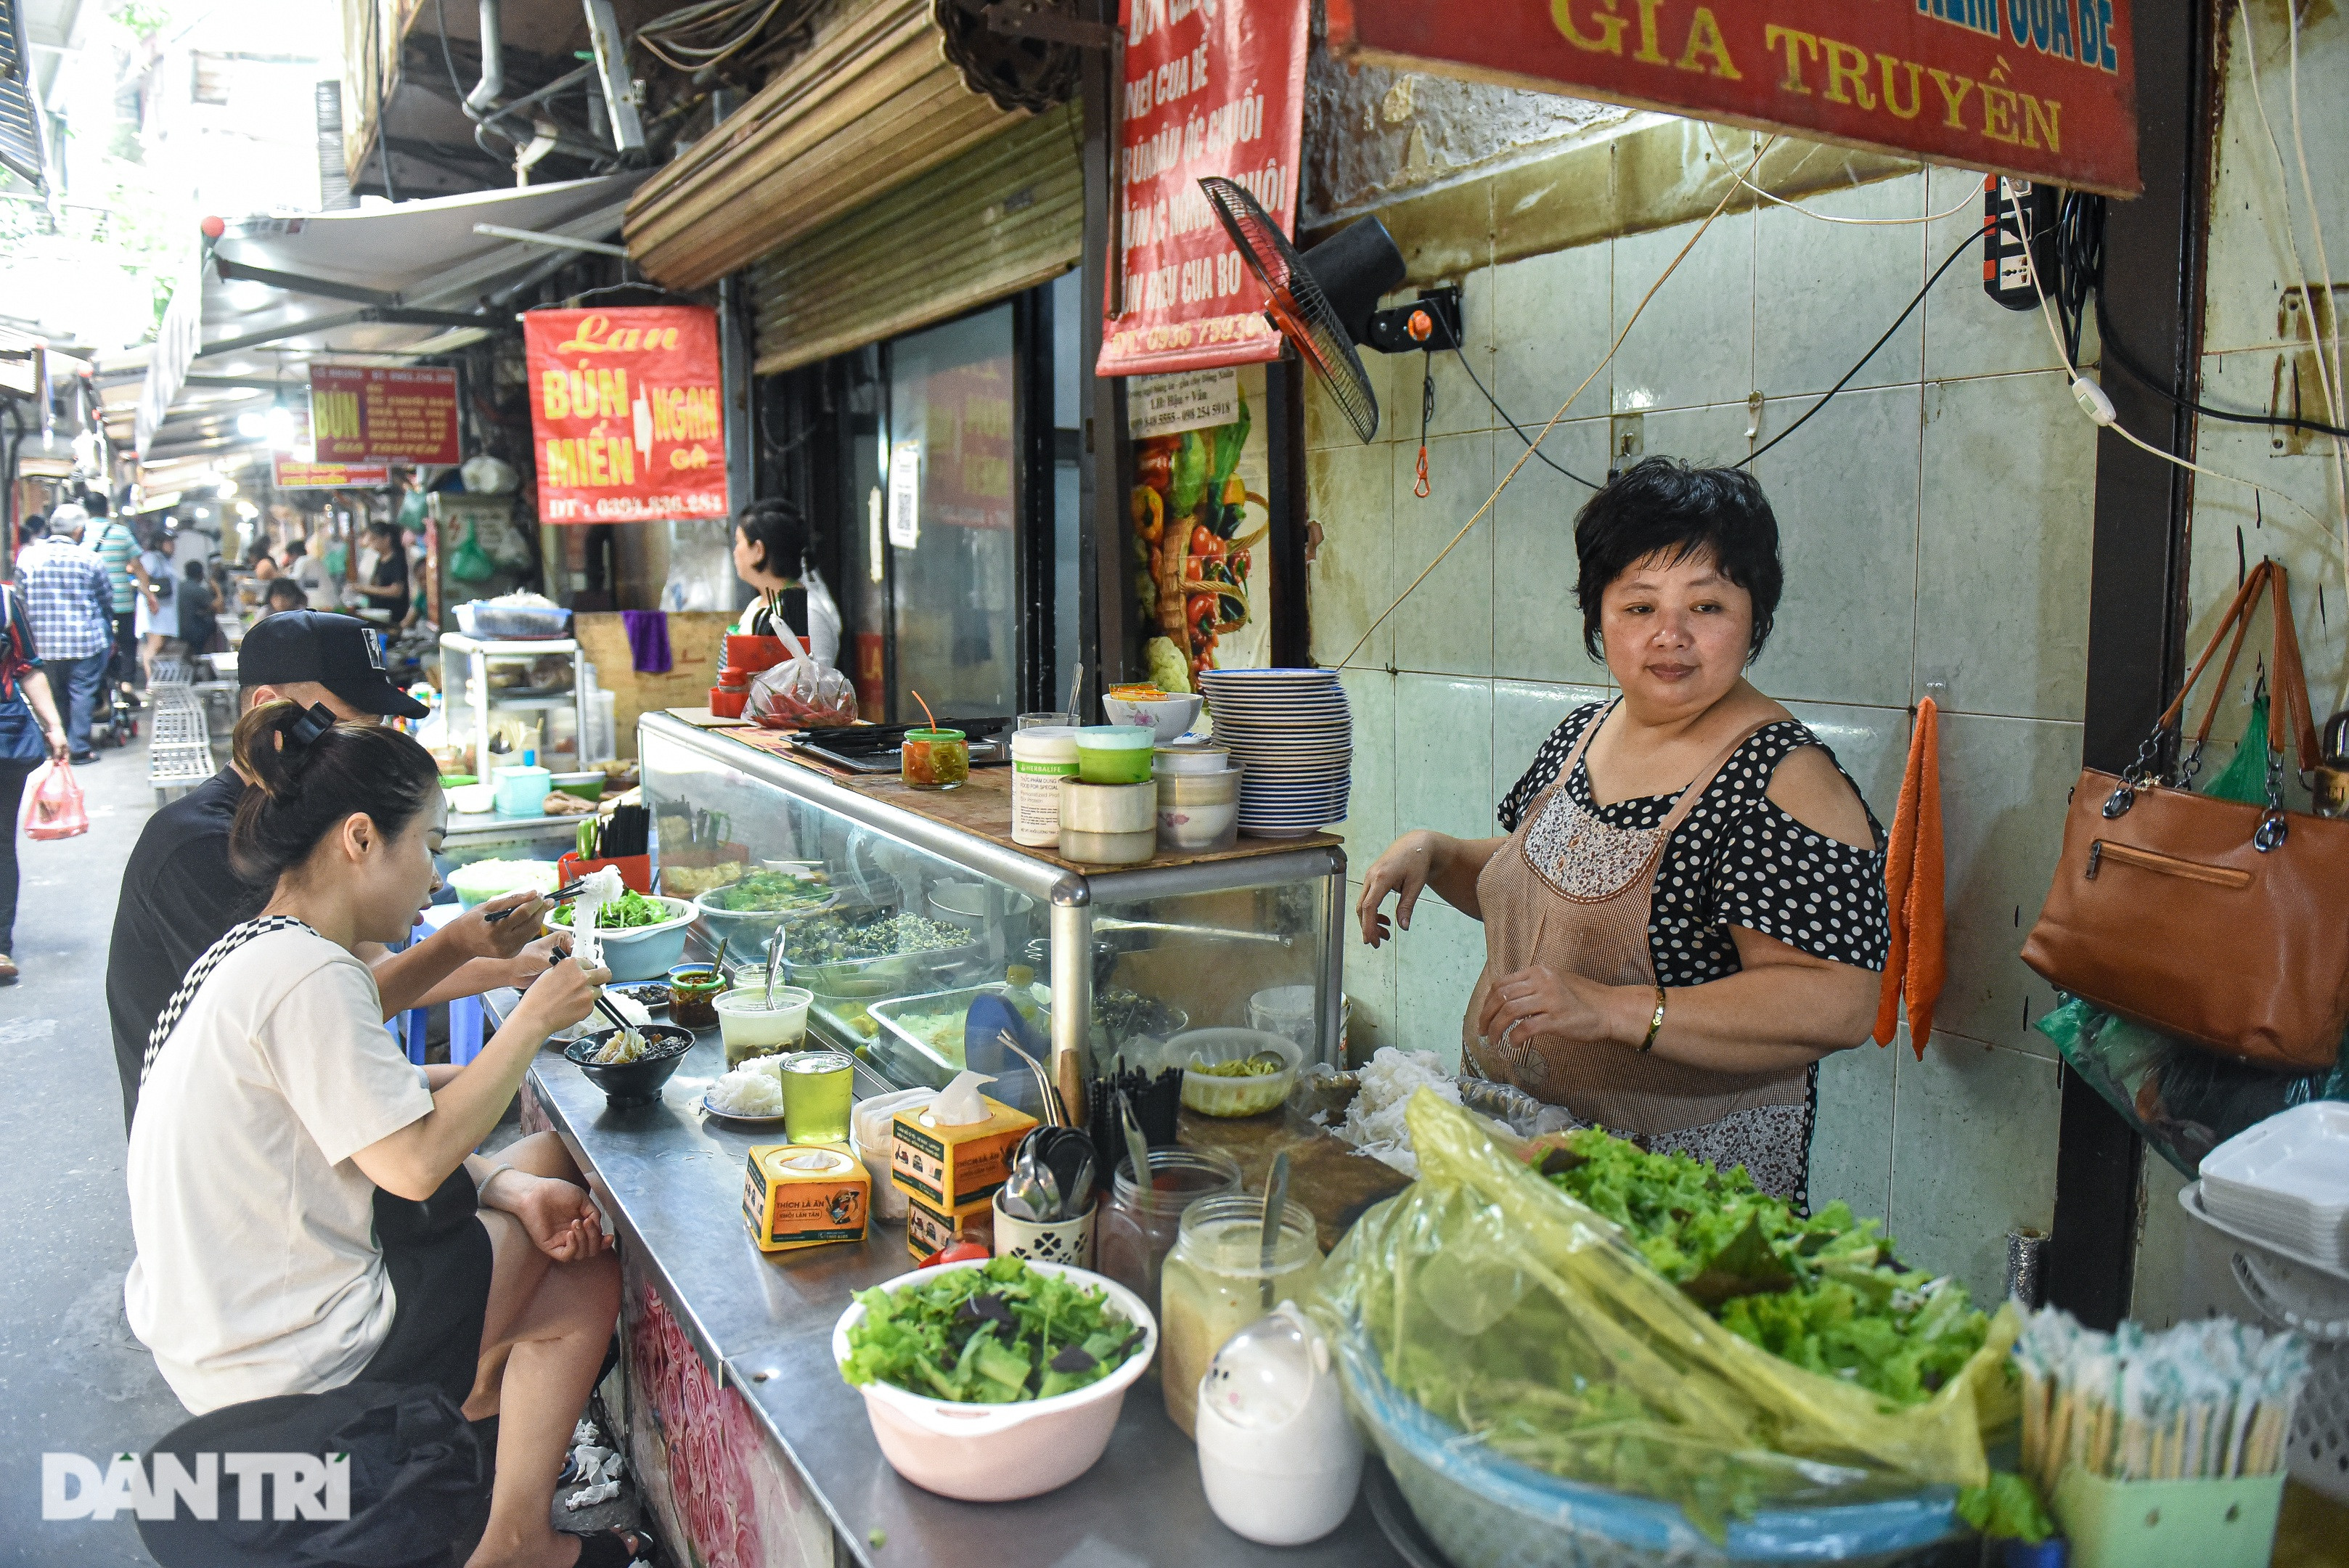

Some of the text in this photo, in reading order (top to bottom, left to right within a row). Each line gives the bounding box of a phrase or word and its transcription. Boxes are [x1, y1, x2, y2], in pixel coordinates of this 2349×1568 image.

[1156, 55, 1188, 105] CUA
[1551, 0, 2062, 154] GIA TRUYỀN
[1206, 78, 1264, 154] CHUỐI
[1182, 256, 1213, 305] CUA
[557, 314, 678, 354] Lan
[314, 382, 359, 440] BÚN
[542, 358, 718, 442] BÚN NGAN
[1197, 406, 1210, 418] 254
[547, 419, 634, 488] MIẾN
[801, 1199, 811, 1208] LÀ
